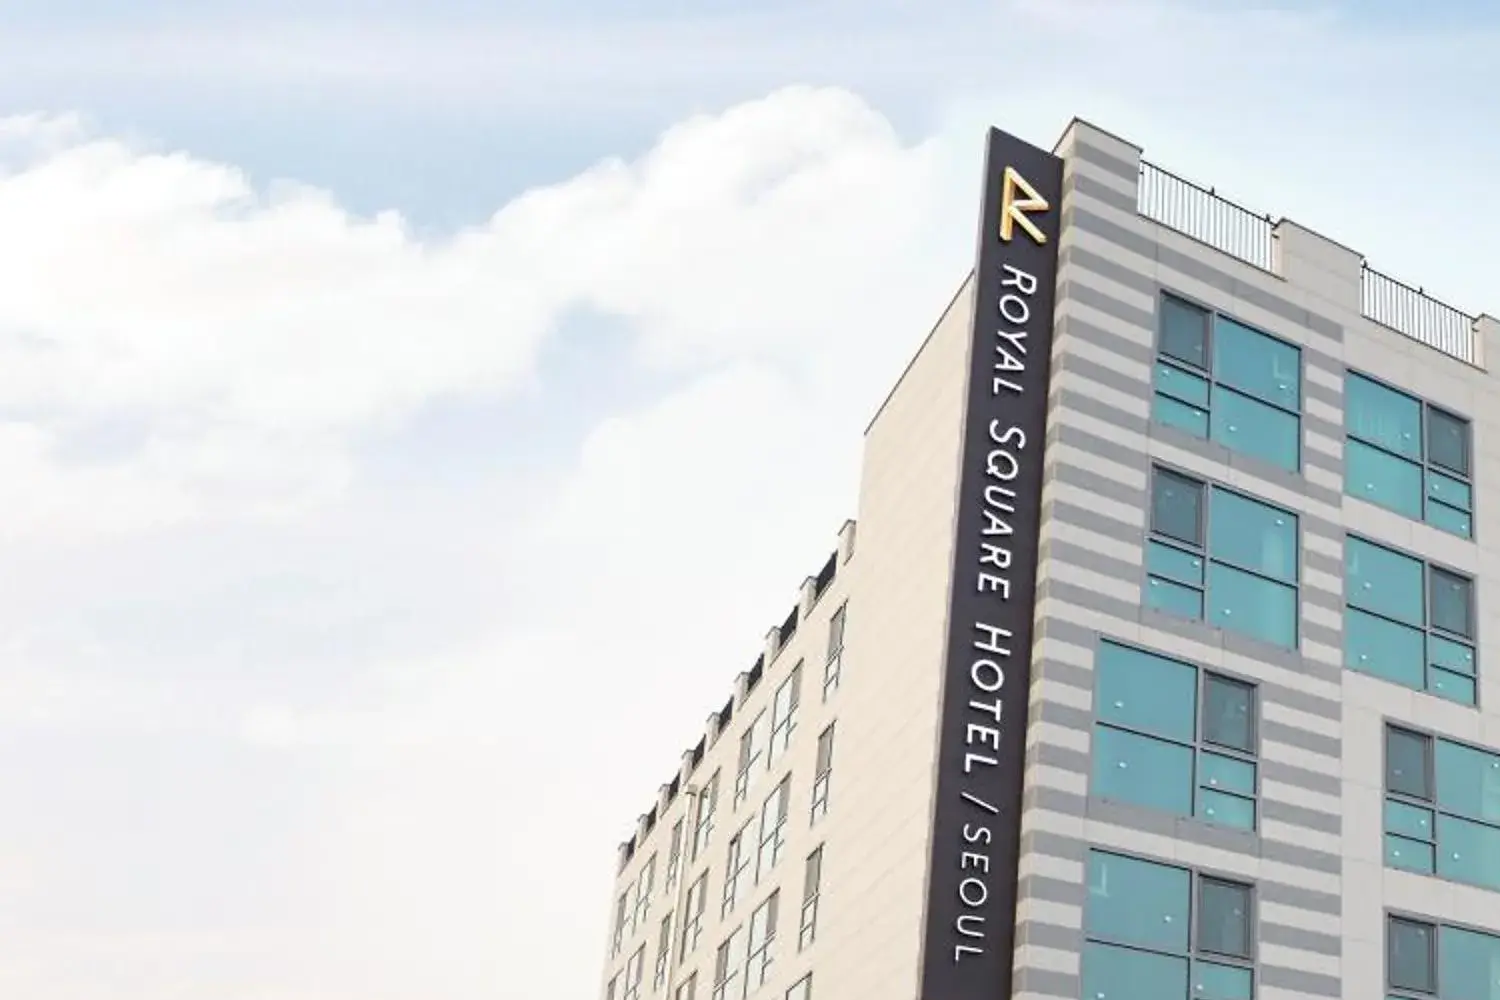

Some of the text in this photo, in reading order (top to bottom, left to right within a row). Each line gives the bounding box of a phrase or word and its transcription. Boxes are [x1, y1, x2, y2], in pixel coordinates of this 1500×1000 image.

[992, 263, 1038, 396] ROYAL
[976, 419, 1026, 600] SQUARE
[964, 620, 1013, 773] HOTEL
[954, 823, 993, 963] SEOUL
